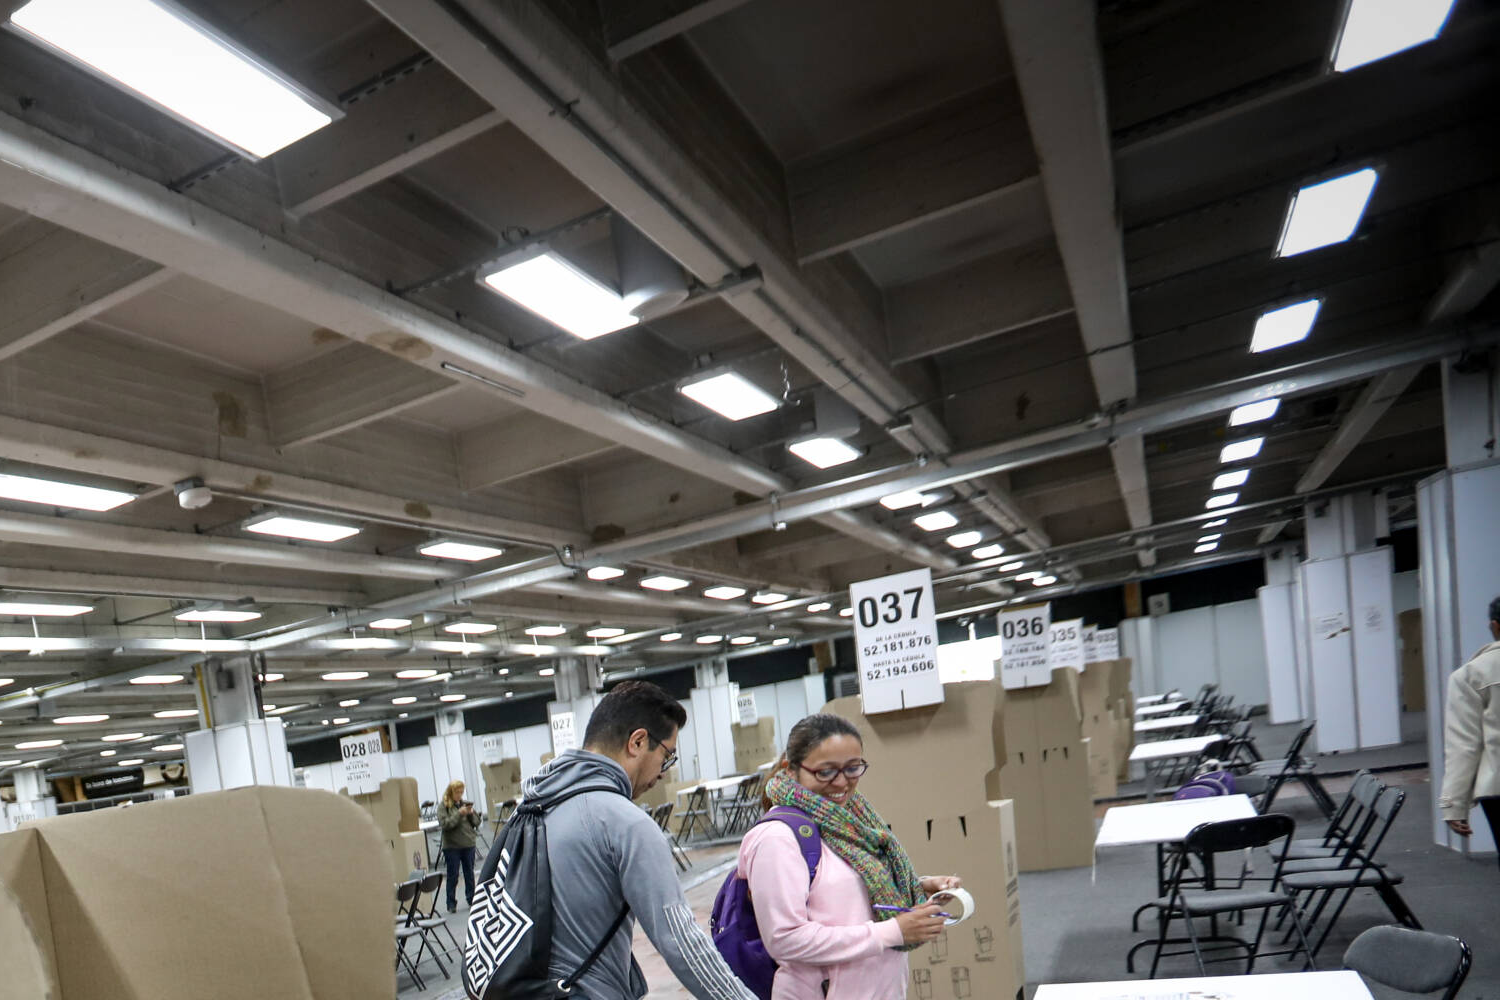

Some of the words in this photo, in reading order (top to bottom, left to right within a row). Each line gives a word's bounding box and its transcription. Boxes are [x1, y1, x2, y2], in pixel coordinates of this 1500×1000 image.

[858, 586, 924, 628] 037
[1002, 616, 1044, 639] 036
[863, 635, 932, 656] 52.181.876
[867, 660, 935, 681] 52.194.606
[553, 717, 571, 730] 027
[342, 742, 366, 758] 028
[368, 738, 380, 754] 028
